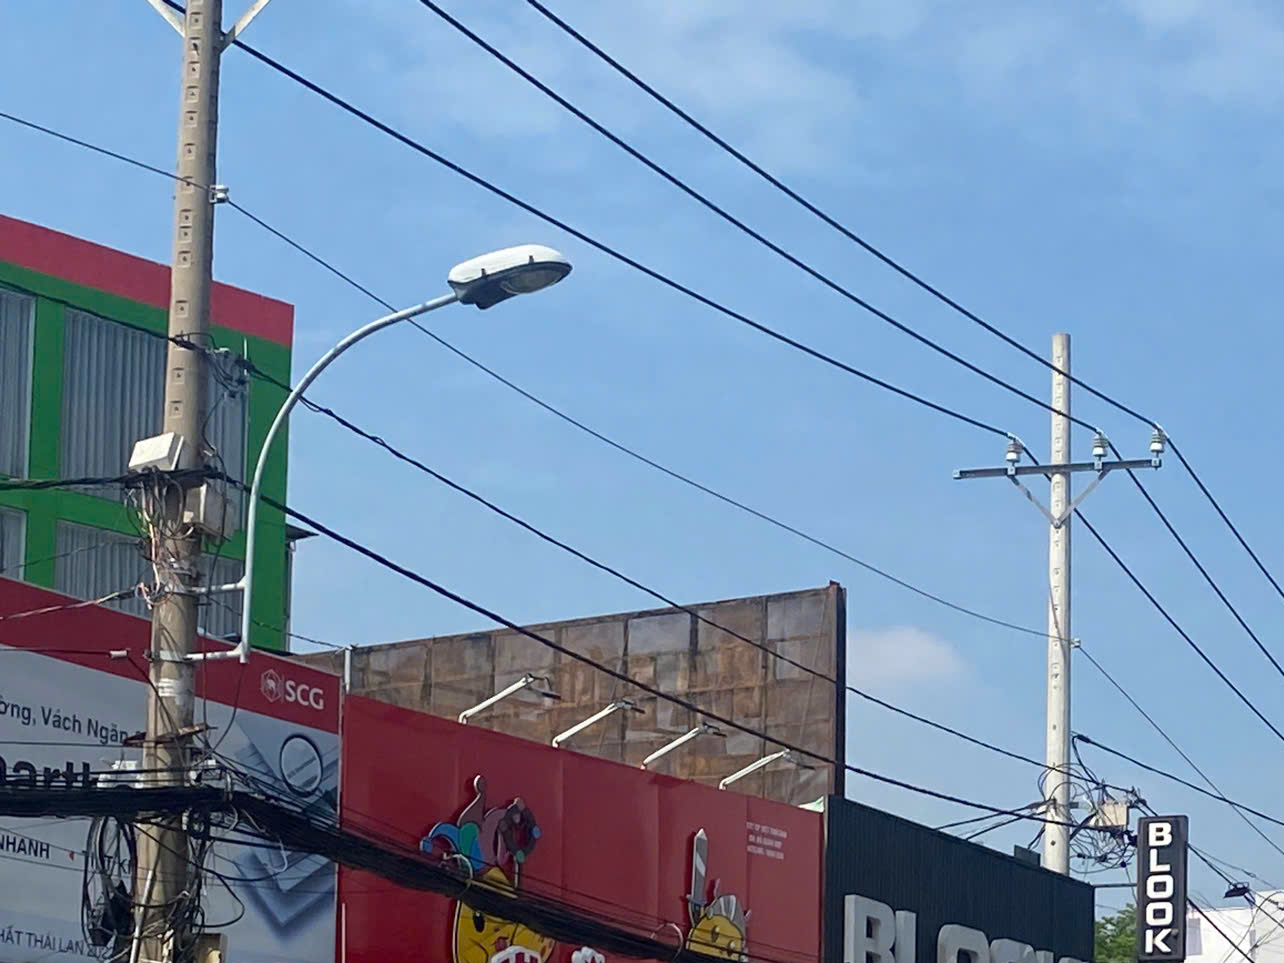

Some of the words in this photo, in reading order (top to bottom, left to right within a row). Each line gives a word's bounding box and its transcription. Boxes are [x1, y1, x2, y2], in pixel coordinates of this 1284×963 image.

[285, 680, 324, 710] SCG
[41, 706, 82, 733] Vách
[1145, 822, 1174, 953] BLOOK
